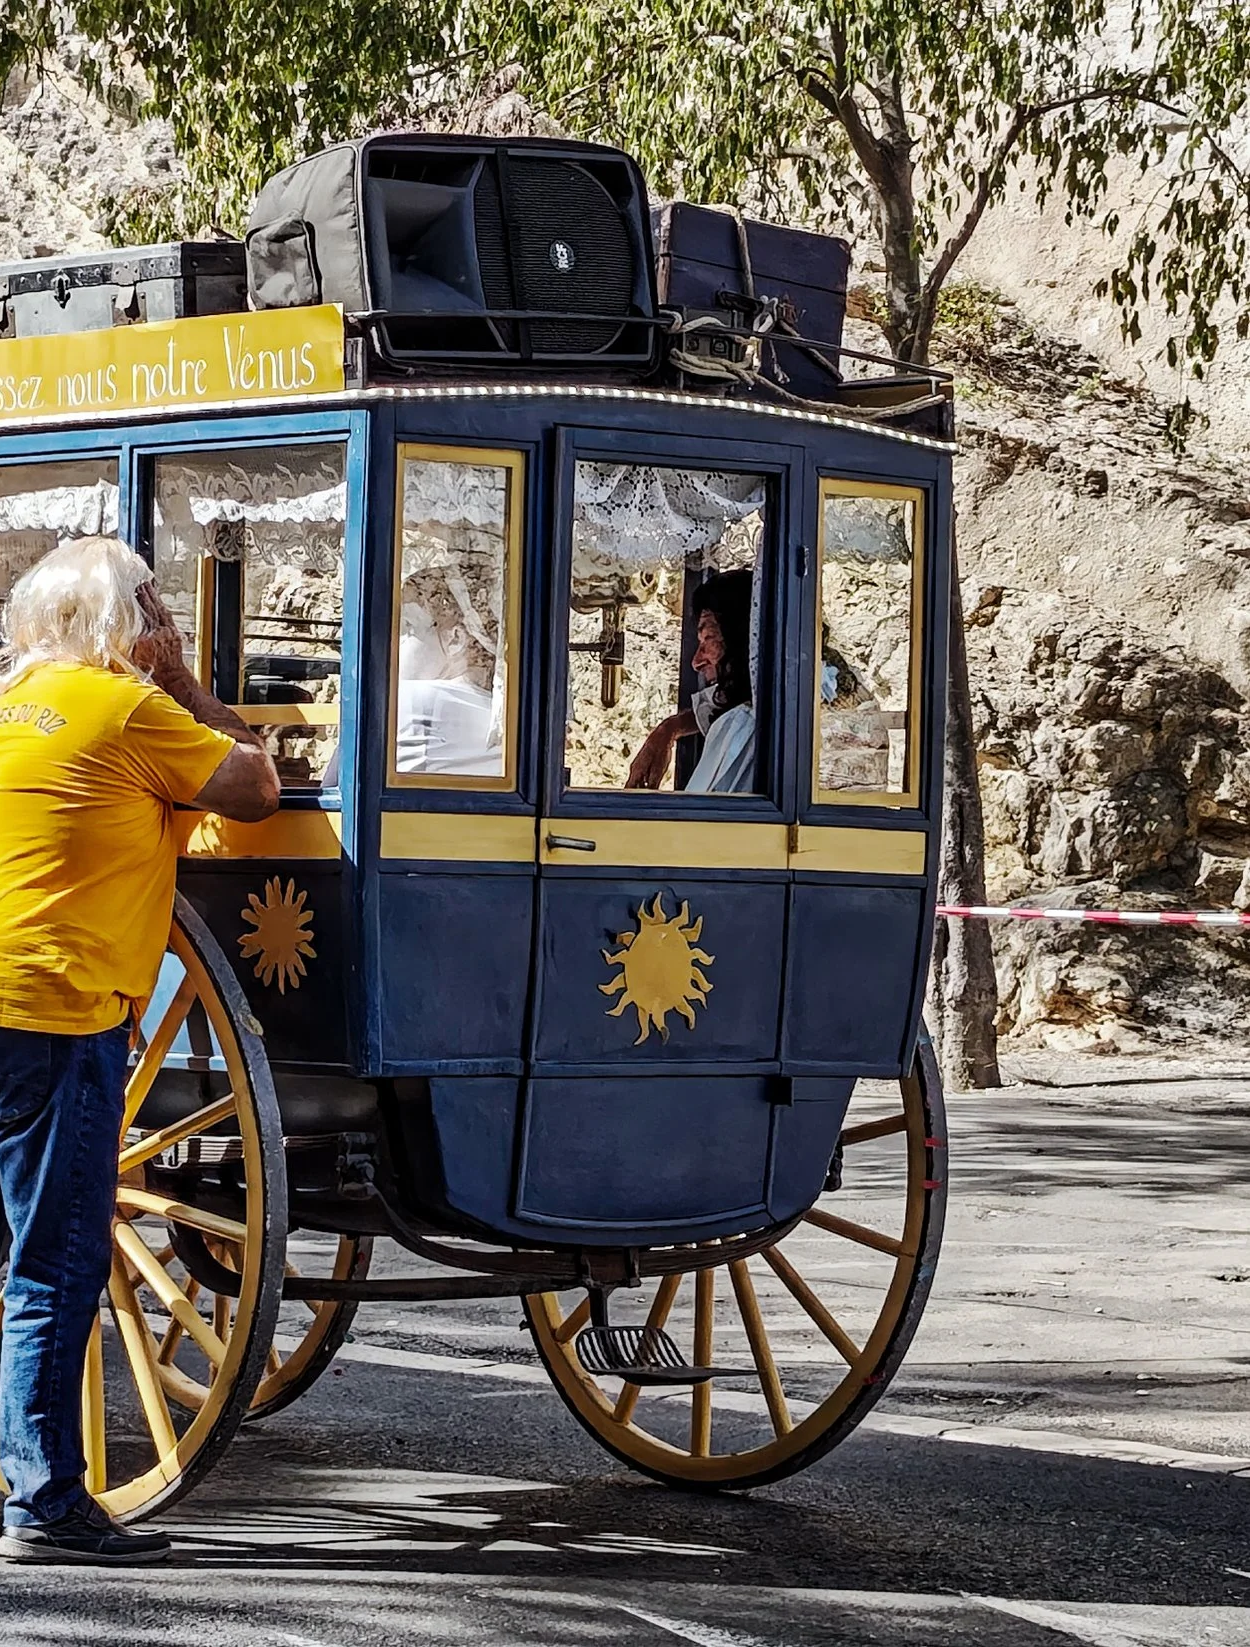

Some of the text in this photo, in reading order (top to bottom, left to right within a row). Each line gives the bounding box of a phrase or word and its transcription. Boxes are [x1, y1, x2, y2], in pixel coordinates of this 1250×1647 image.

[555, 243, 569, 269] RCF
[57, 363, 118, 407] nous
[132, 335, 209, 403] notre
[35, 708, 68, 735] RIZ
